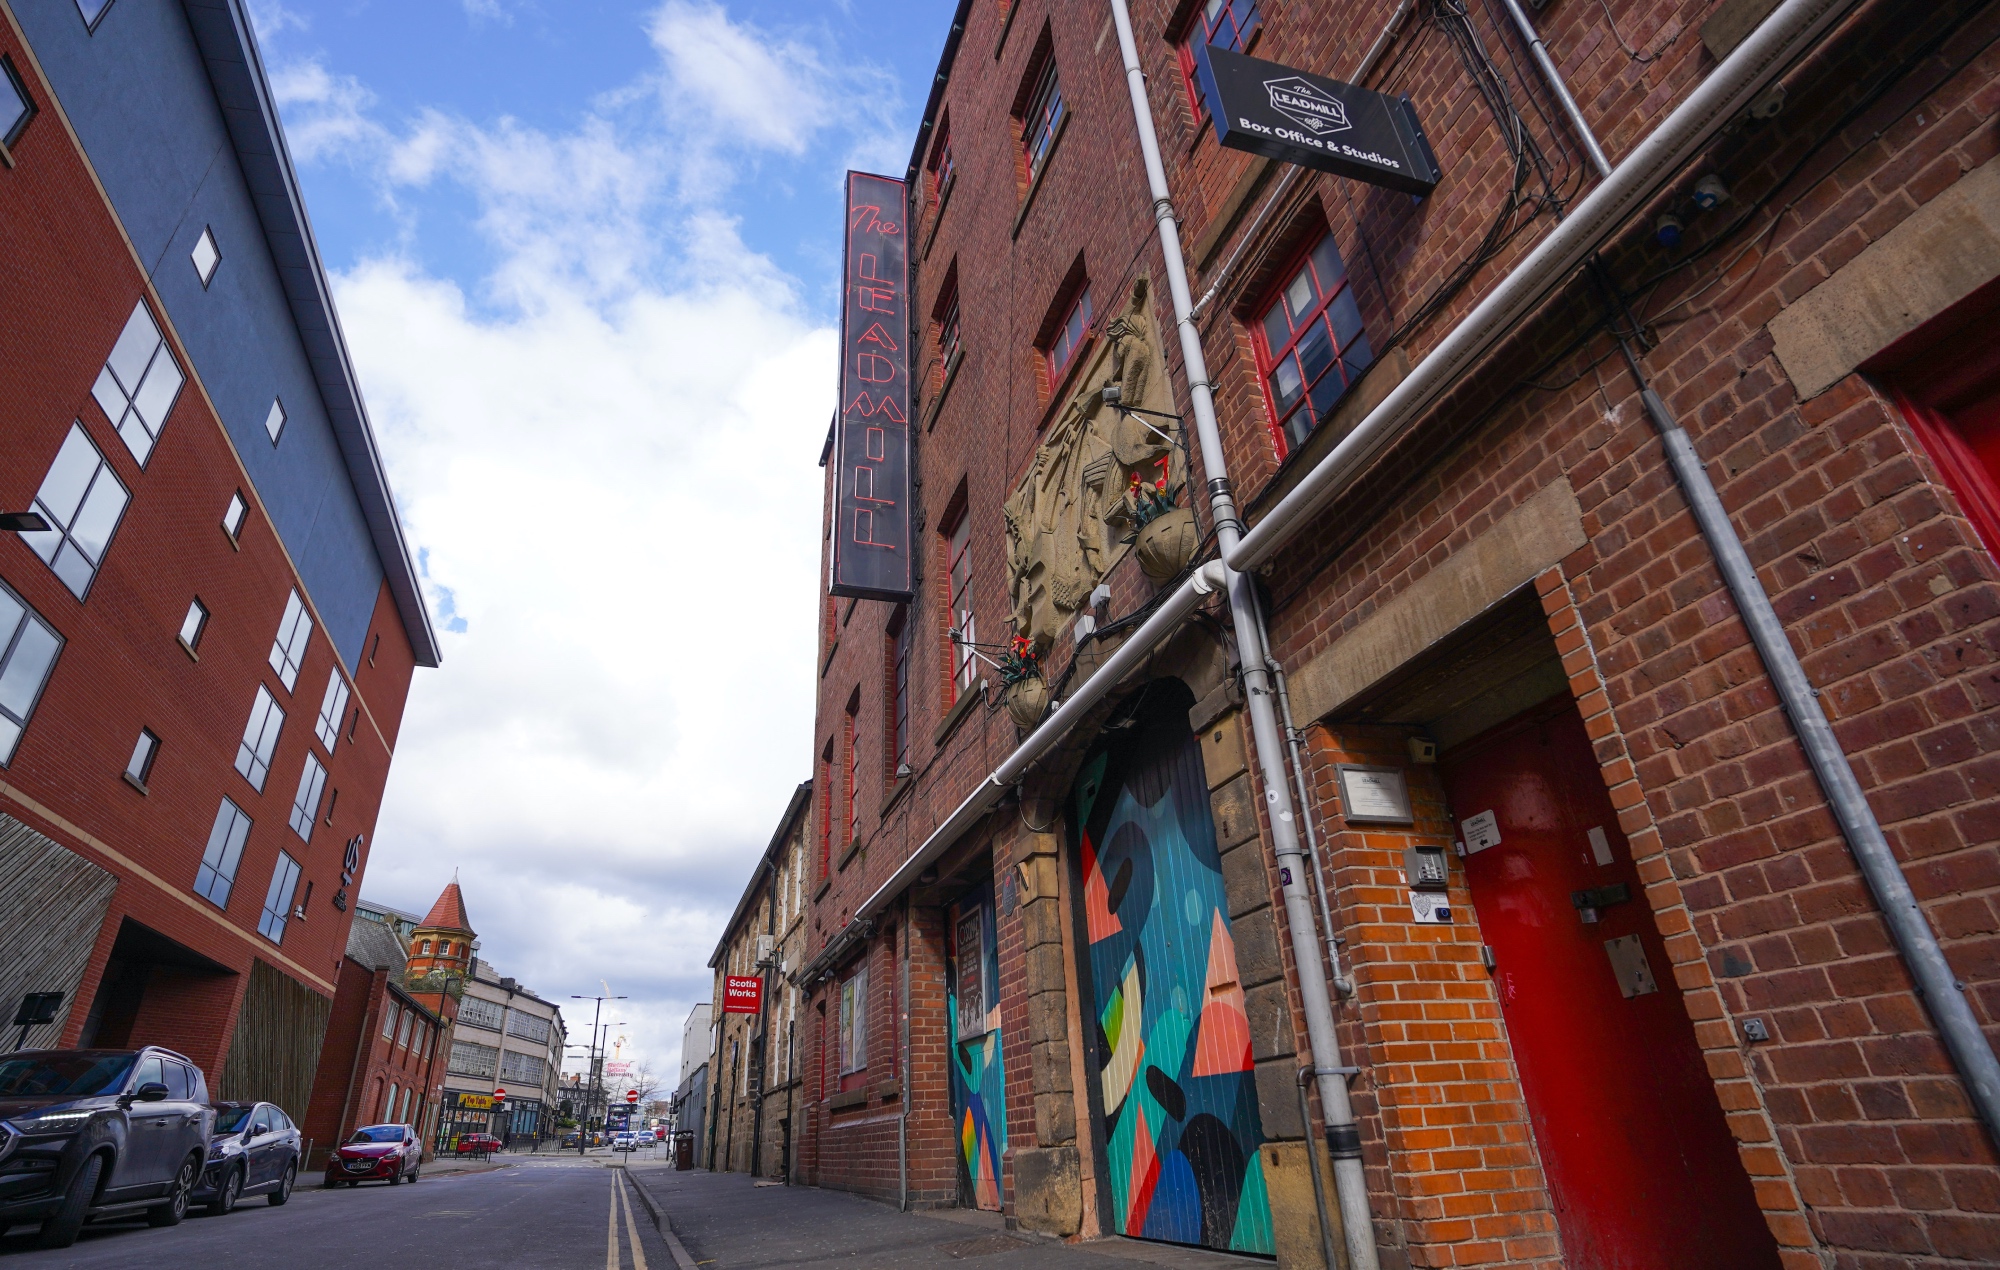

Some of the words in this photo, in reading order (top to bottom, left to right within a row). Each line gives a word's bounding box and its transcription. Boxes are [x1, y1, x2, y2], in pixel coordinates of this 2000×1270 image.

[1293, 85, 1312, 96] The
[1274, 91, 1341, 118] LEADMILL
[1239, 117, 1272, 136] Box
[1274, 127, 1323, 149] Office
[1326, 140, 1341, 154] &
[1341, 144, 1400, 170] Studios
[852, 205, 900, 234] The
[844, 252, 906, 549] LEADMILL
[728, 988, 757, 998] Works
[729, 979, 757, 988] Scotia
